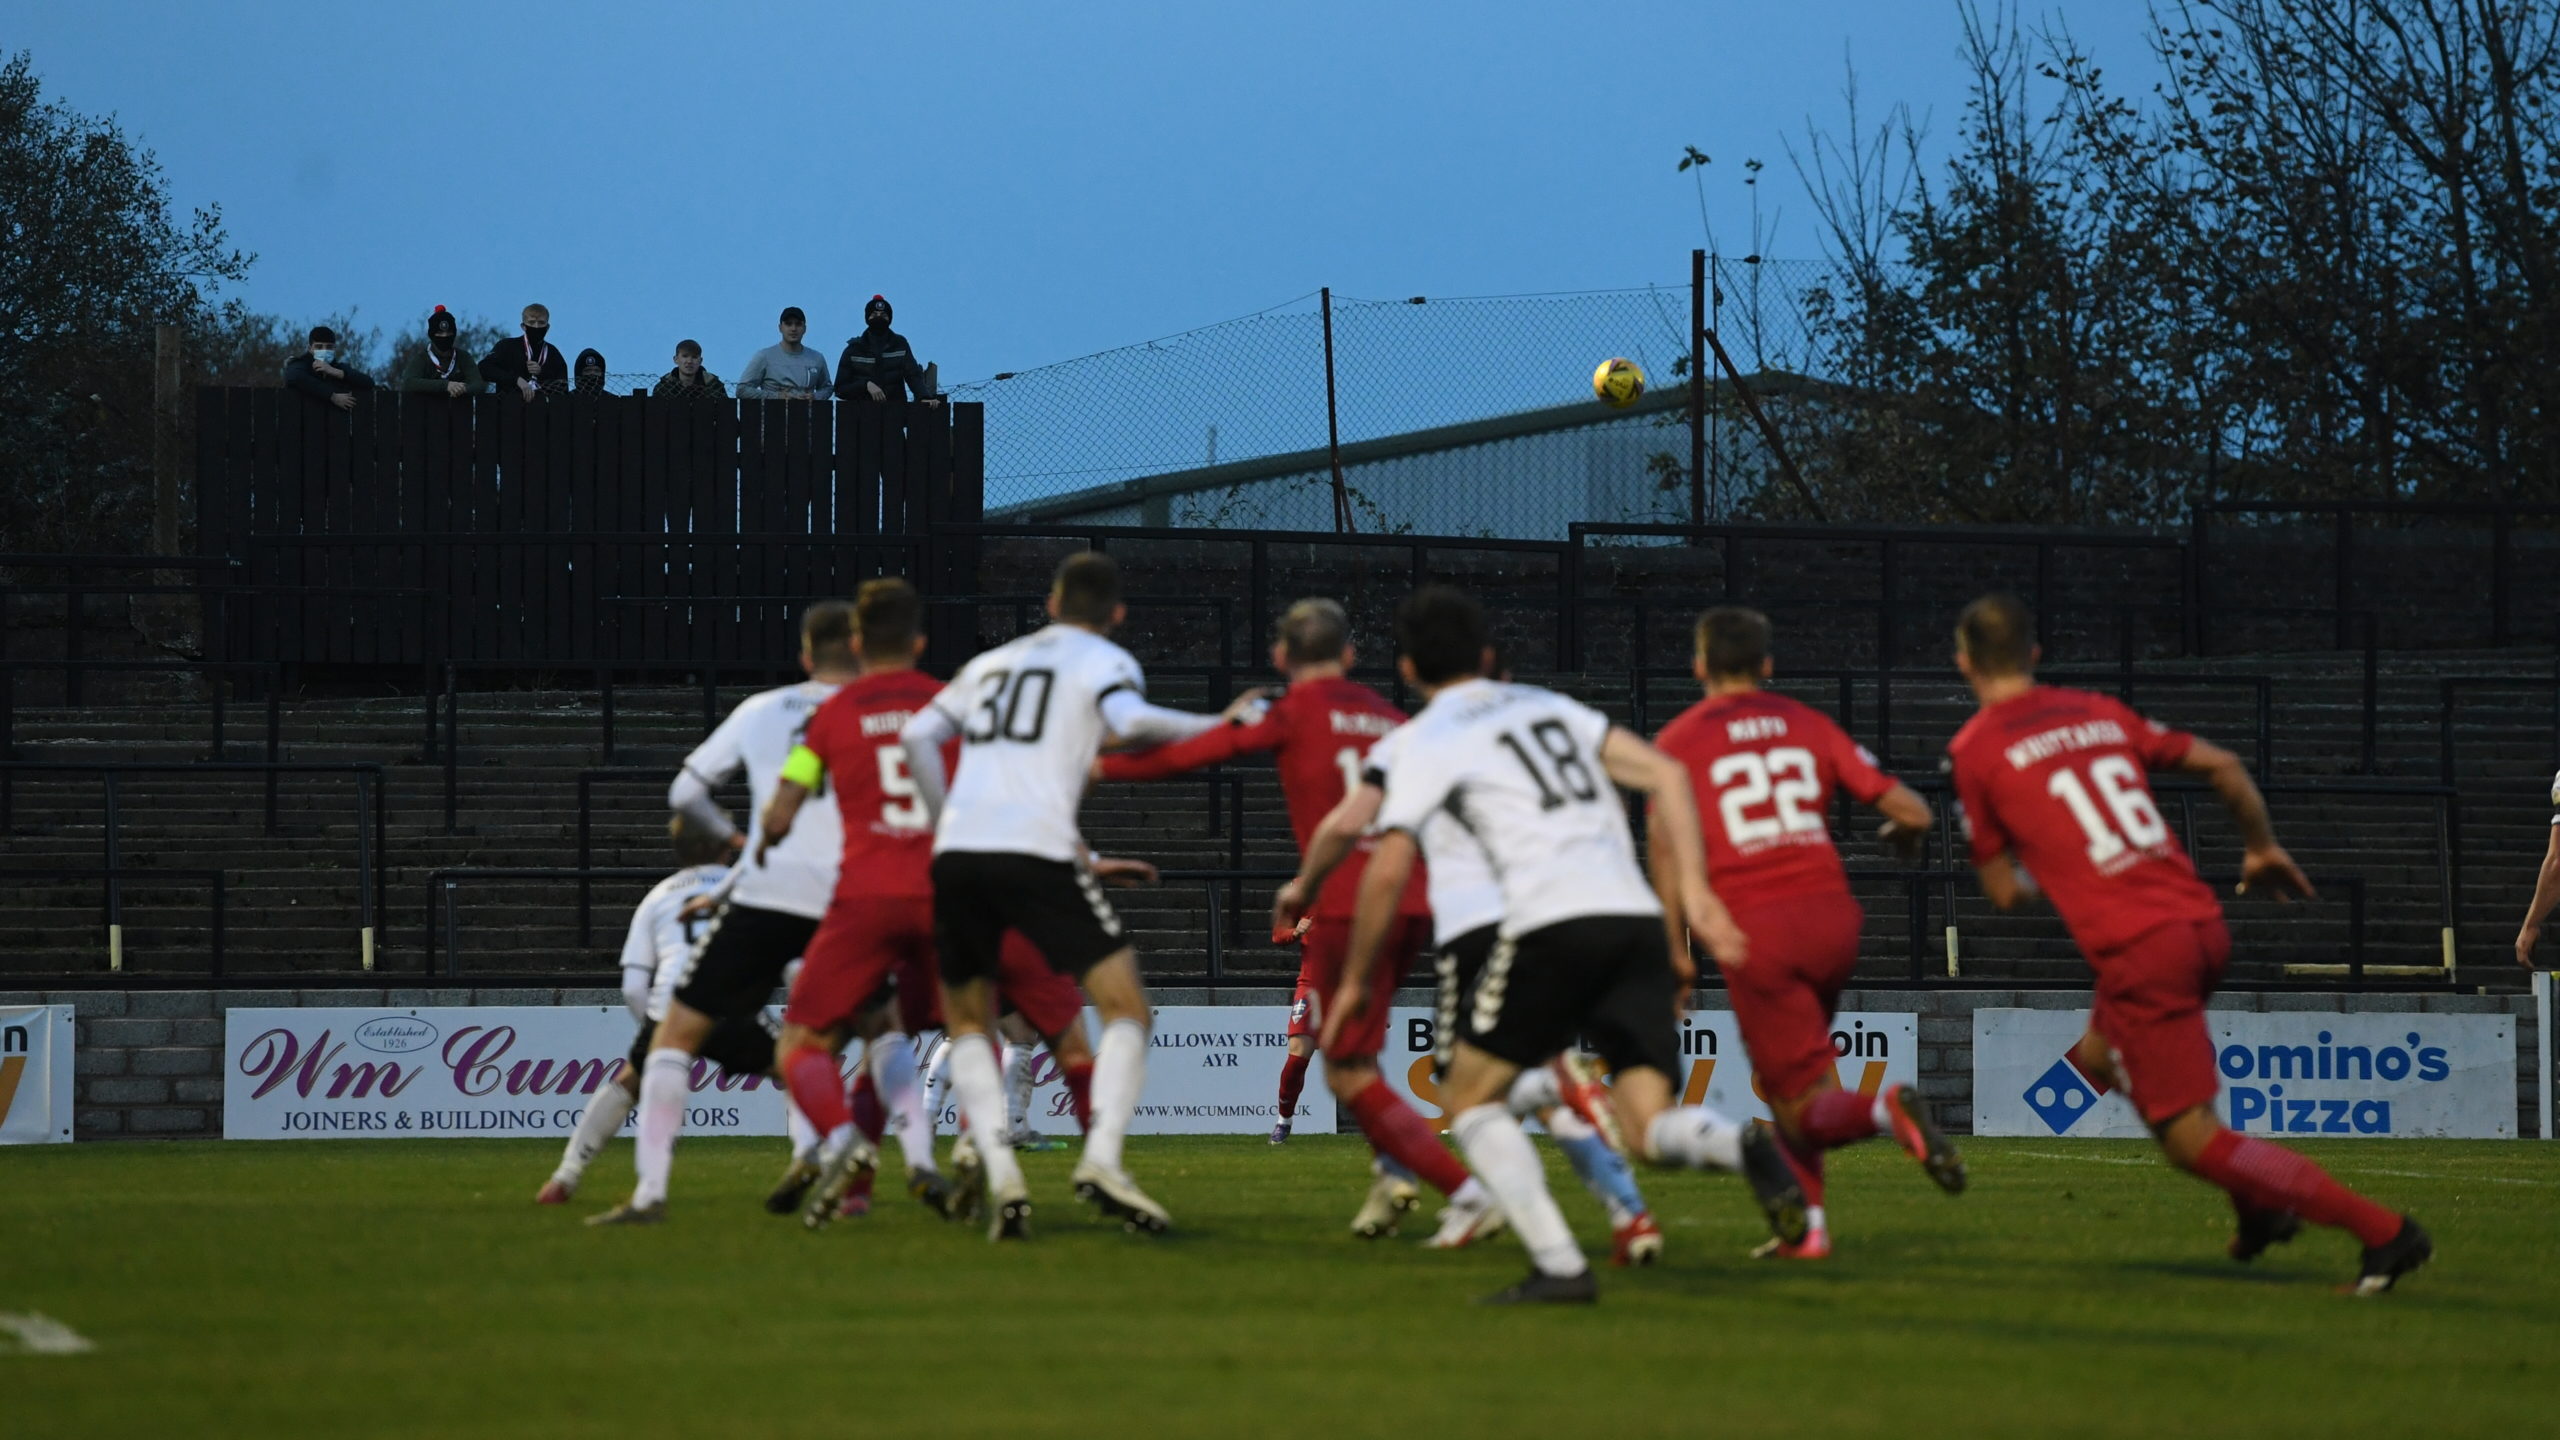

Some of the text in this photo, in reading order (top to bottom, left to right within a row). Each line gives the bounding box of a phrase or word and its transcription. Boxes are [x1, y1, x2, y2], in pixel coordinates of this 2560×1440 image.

[965, 669, 1055, 744] 30
[876, 744, 931, 829] 5
[1498, 717, 1598, 813] 18
[1709, 746, 1824, 846] 22
[2048, 754, 2167, 866] 16
[363, 1026, 428, 1037] Established
[382, 1038, 407, 1049] 1926
[1150, 1033, 1289, 1048] ALLOWAY STRE
[2210, 1030, 2450, 1083] omino's
[239, 1028, 424, 1101] Wm
[1202, 1053, 1239, 1067] AYR
[281, 1107, 740, 1131] JOINERS & BUILDING CORTORS
[1133, 1104, 1312, 1117] WWW.WMCUMMING.CUK
[2229, 1083, 2391, 1134] Pizza
